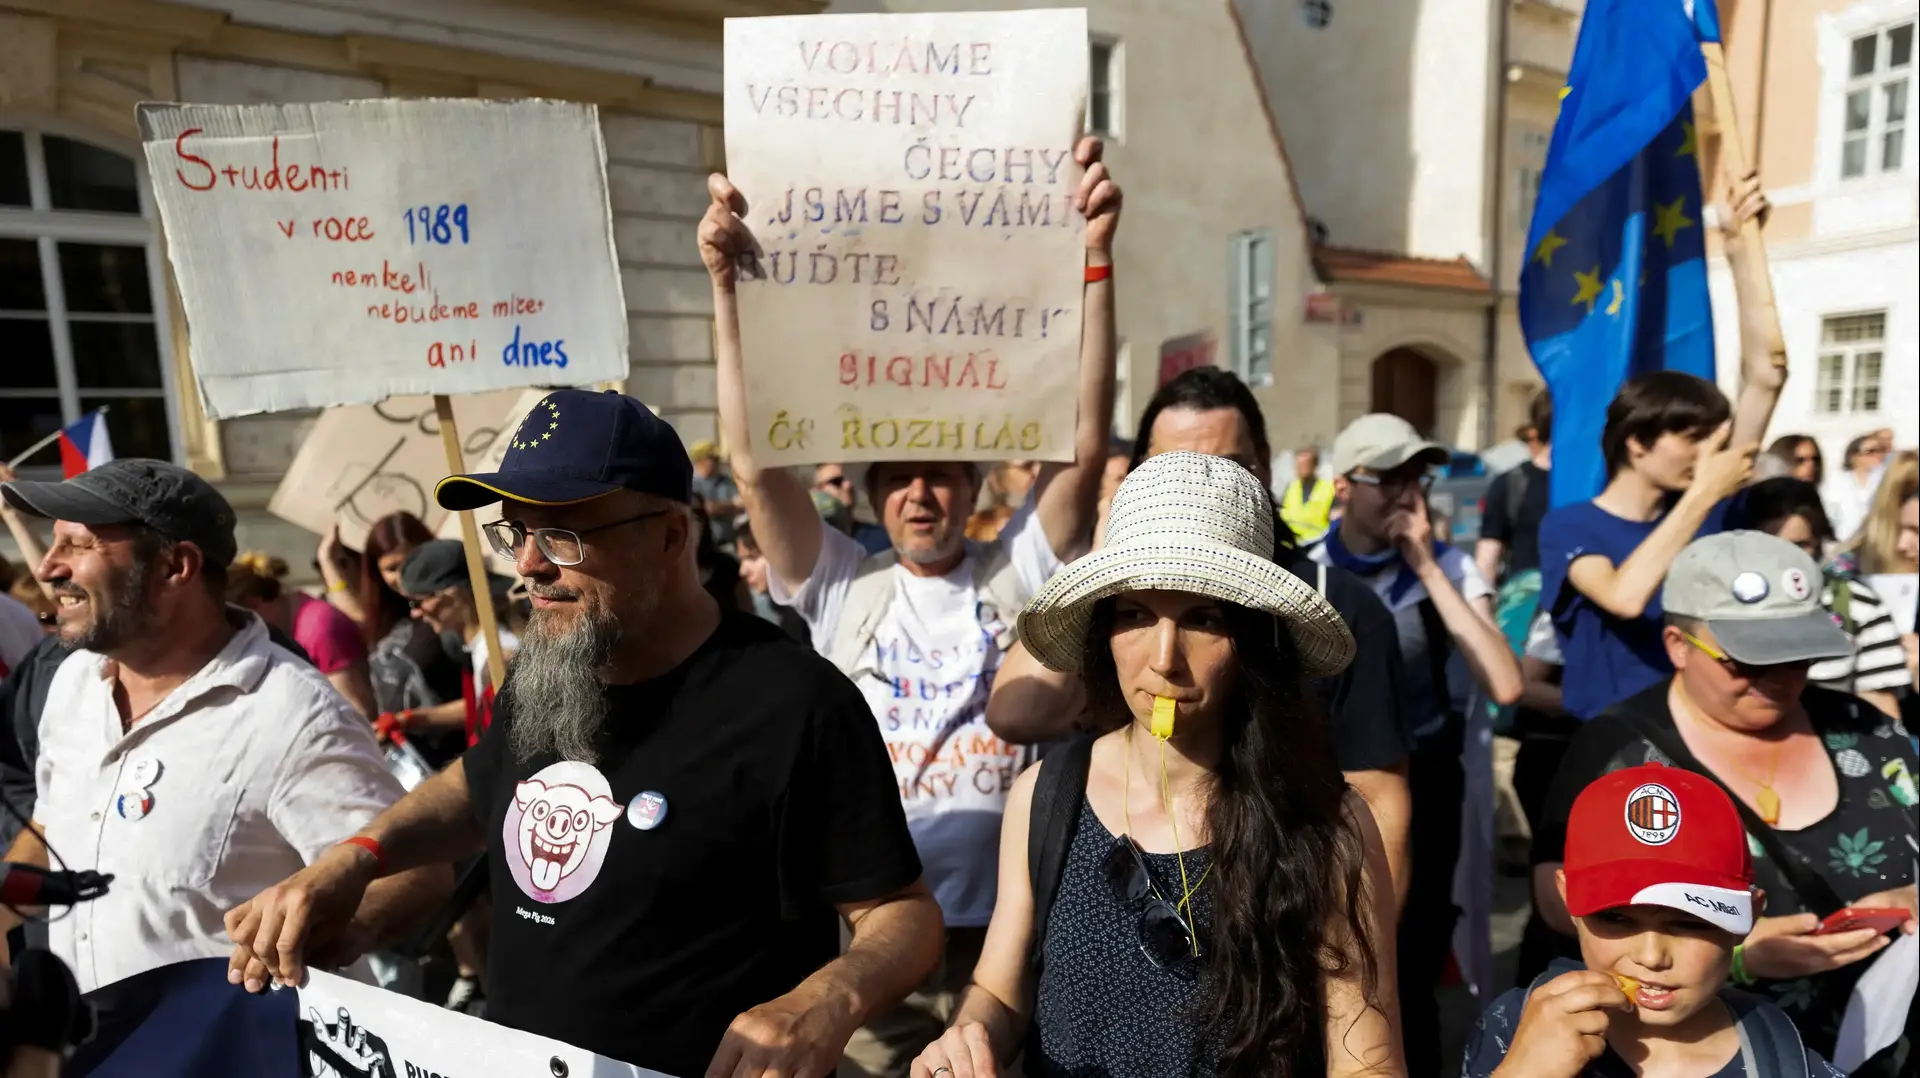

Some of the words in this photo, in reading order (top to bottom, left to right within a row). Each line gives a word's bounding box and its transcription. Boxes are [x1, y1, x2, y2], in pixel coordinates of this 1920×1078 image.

[799, 36, 993, 76] VOLÁME
[175, 128, 349, 192] Studenti
[904, 137, 1068, 184] ČECHY
[313, 216, 374, 242] roce
[403, 203, 469, 245] 1989
[921, 190, 943, 225] S
[368, 288, 479, 324] nebudeme
[870, 299, 889, 332] S
[427, 339, 476, 368] ani
[503, 325, 568, 368] dnes
[838, 351, 1008, 391] SIGNÁL
[1641, 830, 1665, 839] 1899
[515, 905, 532, 920] Mega
[531, 911, 541, 924] Pig
[540, 914, 556, 926] 2026
[1684, 892, 1710, 908] AC
[1708, 899, 1741, 916] Milan
